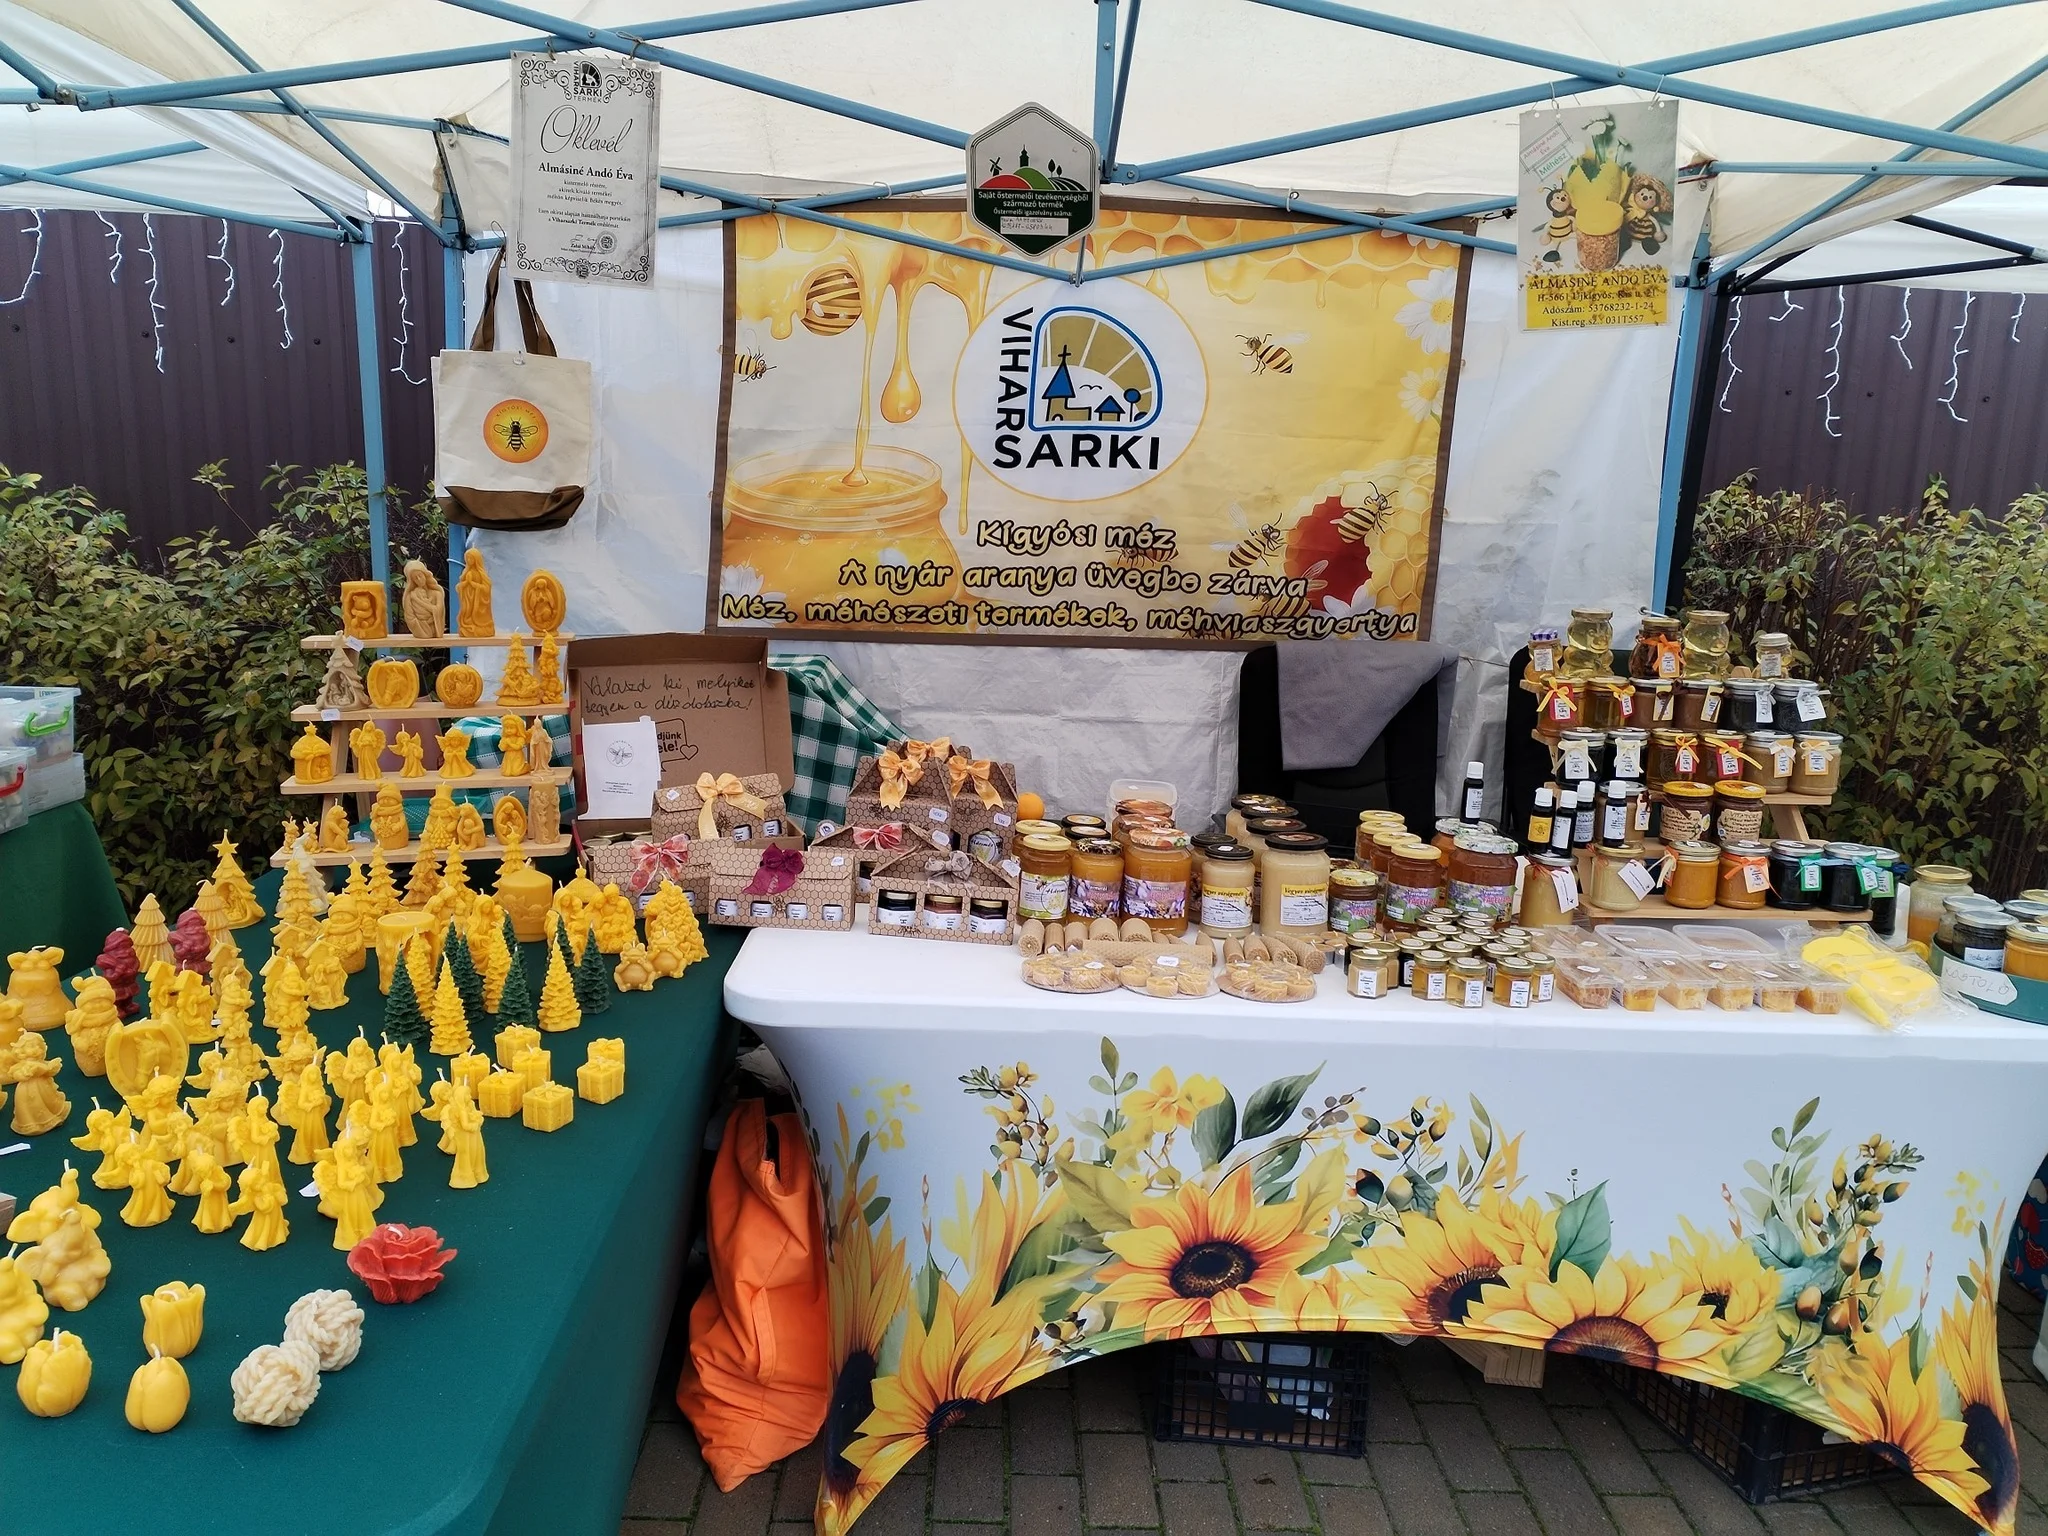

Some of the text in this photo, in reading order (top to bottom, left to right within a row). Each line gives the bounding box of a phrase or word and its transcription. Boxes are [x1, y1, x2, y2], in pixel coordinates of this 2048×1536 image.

[573, 87, 602, 97] SARKI
[540, 104, 633, 154] Oklevél
[538, 162, 634, 180] Almásiné Andó Éva
[978, 192, 996, 200] Saját
[1035, 194, 1089, 202] tevékenységből
[1003, 200, 1037, 208] származó
[1530, 272, 1668, 290] ALMÁSINÉ ANDÓ ÉVA
[1542, 302, 1654, 315] Adószám: 53768232-1-24
[995, 306, 1034, 432] VIHAR
[992, 433, 1160, 470] SARKI
[1104, 522, 1177, 550] méz
[838, 557, 1308, 599] A nyár aranya üvegbe zárva
[720, 594, 1419, 642] Méz, méhészeti termékek, méhviaszgyertya
[634, 701, 648, 709] a
[656, 732, 682, 742] djünk
[658, 741, 679, 754] ele!
